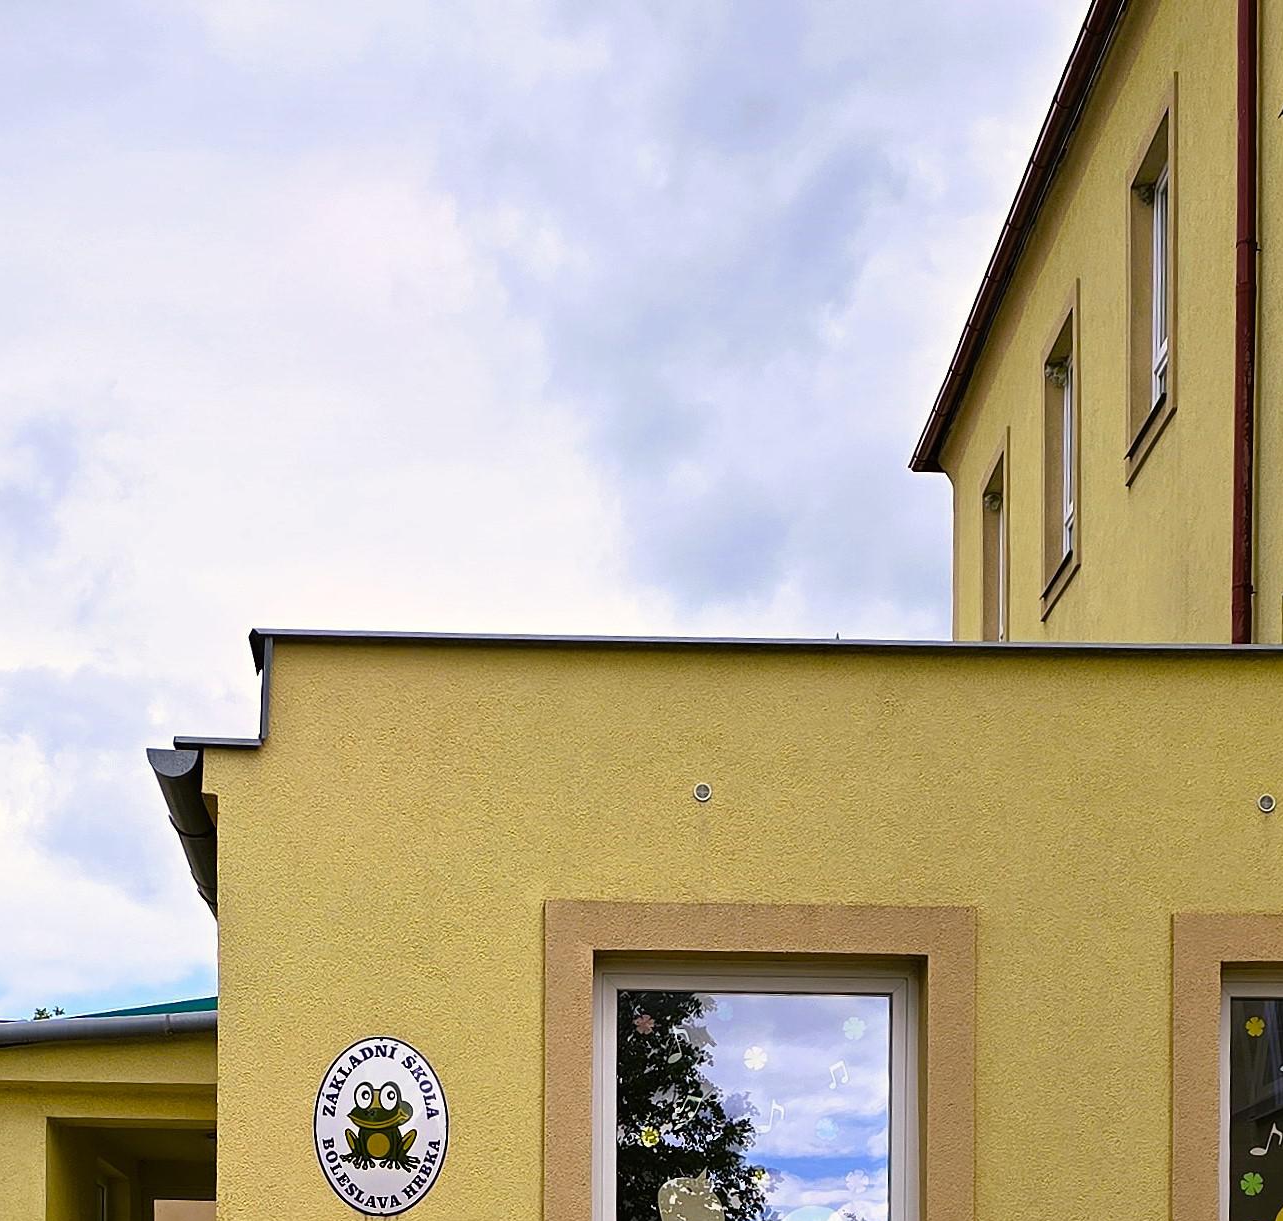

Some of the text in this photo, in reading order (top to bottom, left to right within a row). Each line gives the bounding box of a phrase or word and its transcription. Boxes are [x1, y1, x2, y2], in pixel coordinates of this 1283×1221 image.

[322, 1043, 440, 1120] ZÁKLADNÍ ŠKOLA
[322, 1137, 441, 1209] BOLESLAVA HRBKA
